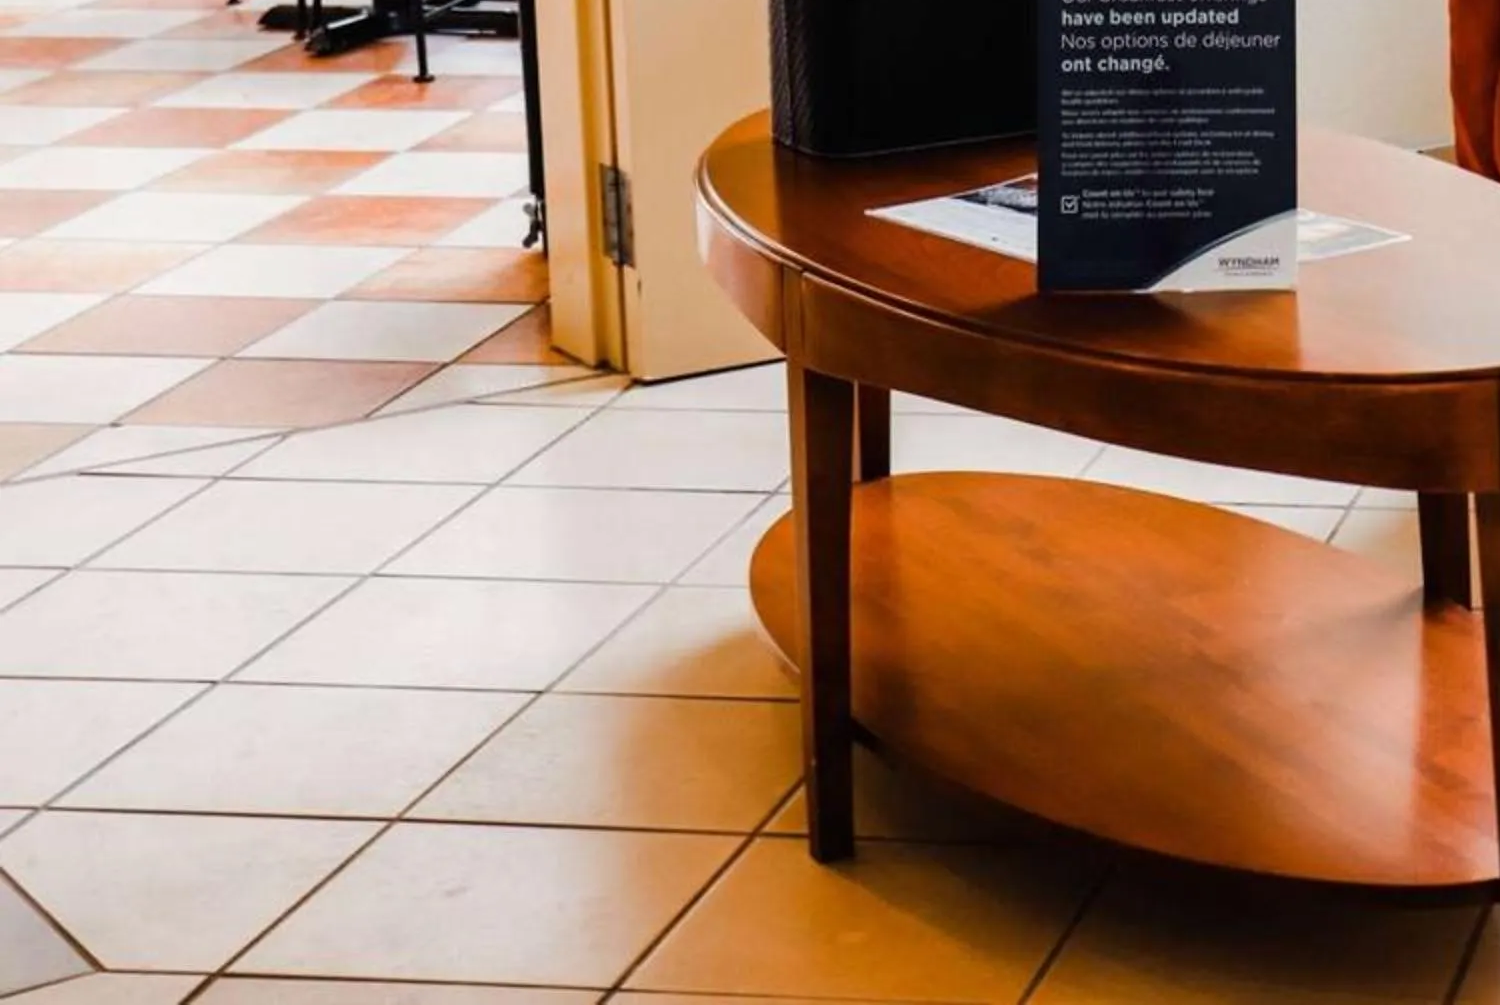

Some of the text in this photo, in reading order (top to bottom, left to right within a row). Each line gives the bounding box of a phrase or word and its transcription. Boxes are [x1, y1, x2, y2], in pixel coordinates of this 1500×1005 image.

[1062, 8, 1239, 27] have been updated
[1061, 32, 1280, 51] Nos options de déjeuner
[1061, 54, 1169, 74] ont changé.
